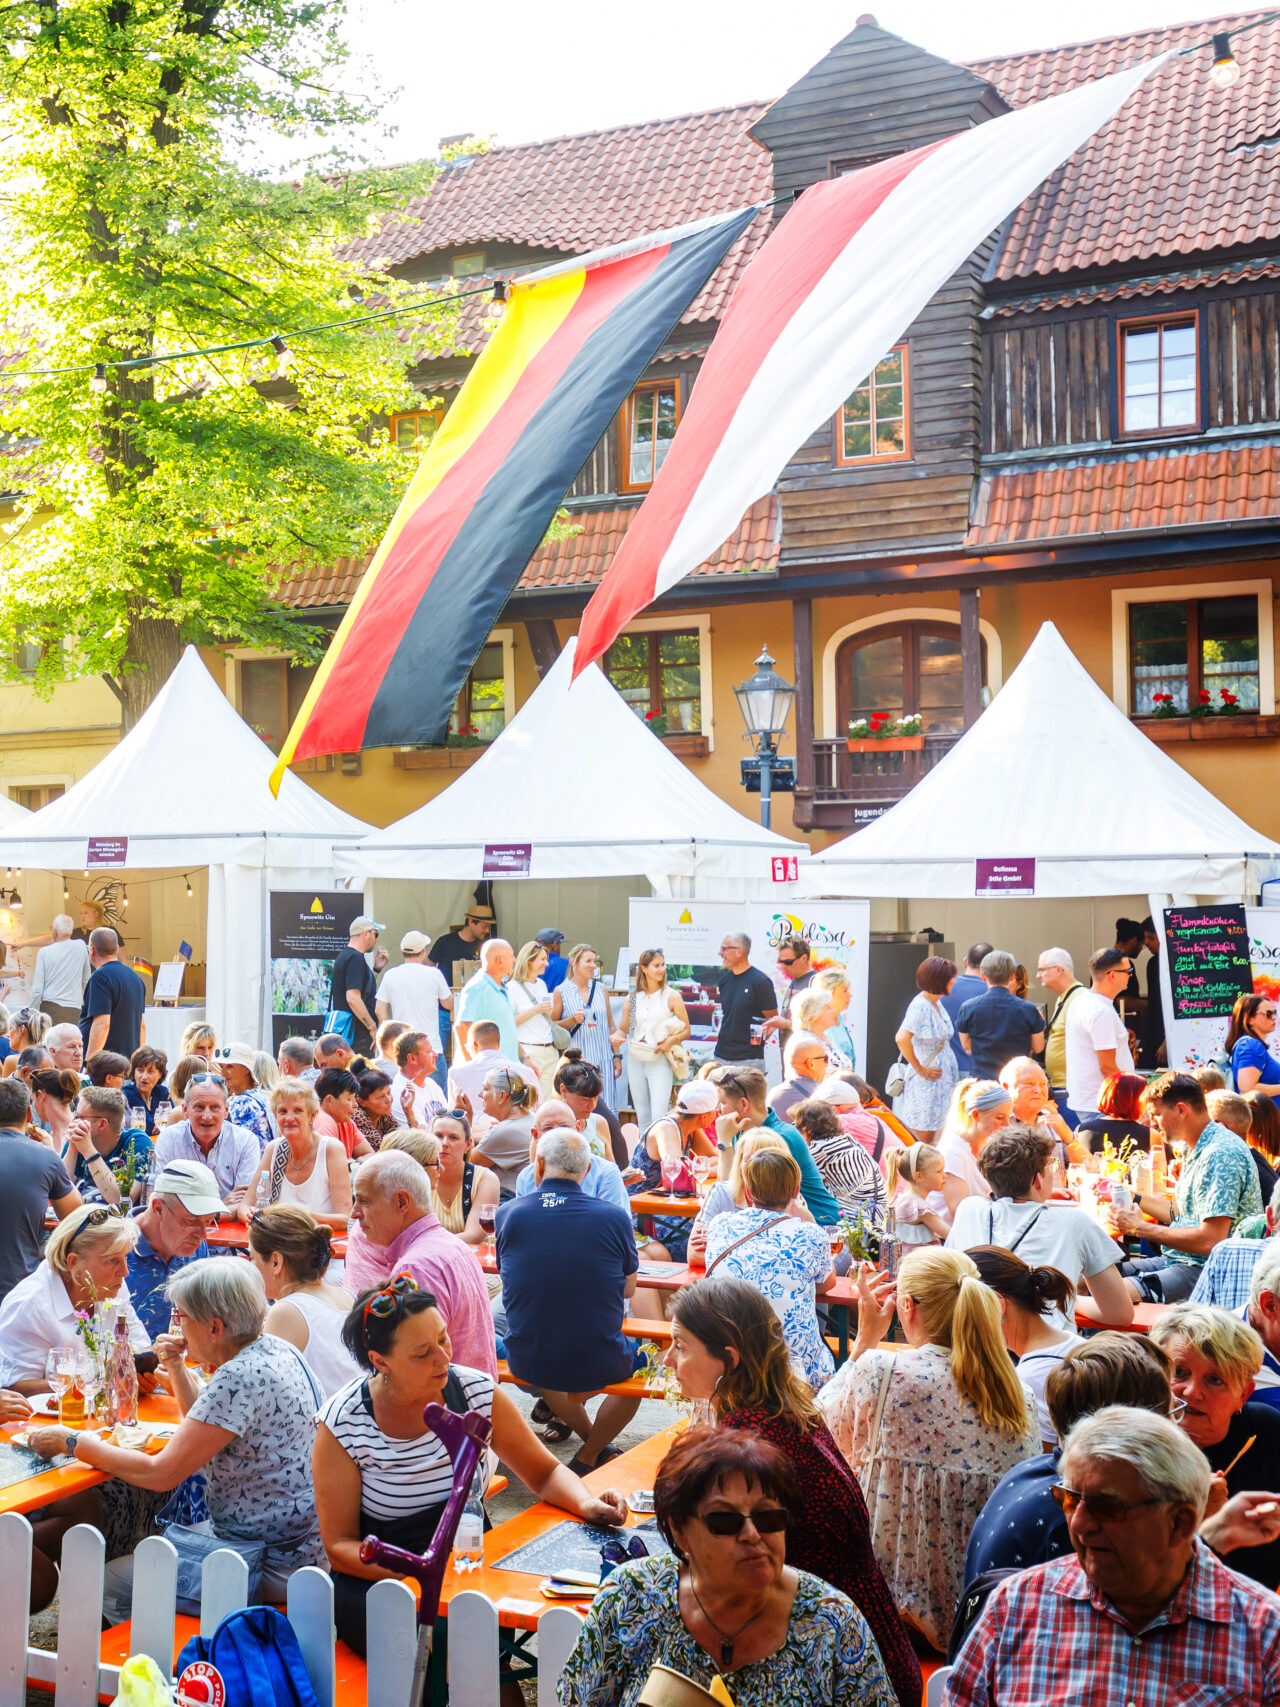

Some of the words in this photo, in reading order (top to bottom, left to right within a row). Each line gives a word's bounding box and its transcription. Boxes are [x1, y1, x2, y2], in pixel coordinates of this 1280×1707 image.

[300, 913, 324, 921] Spreewitz
[1170, 914, 1238, 928] Flammkuchen
[184, 1664, 214, 1682] STOP
